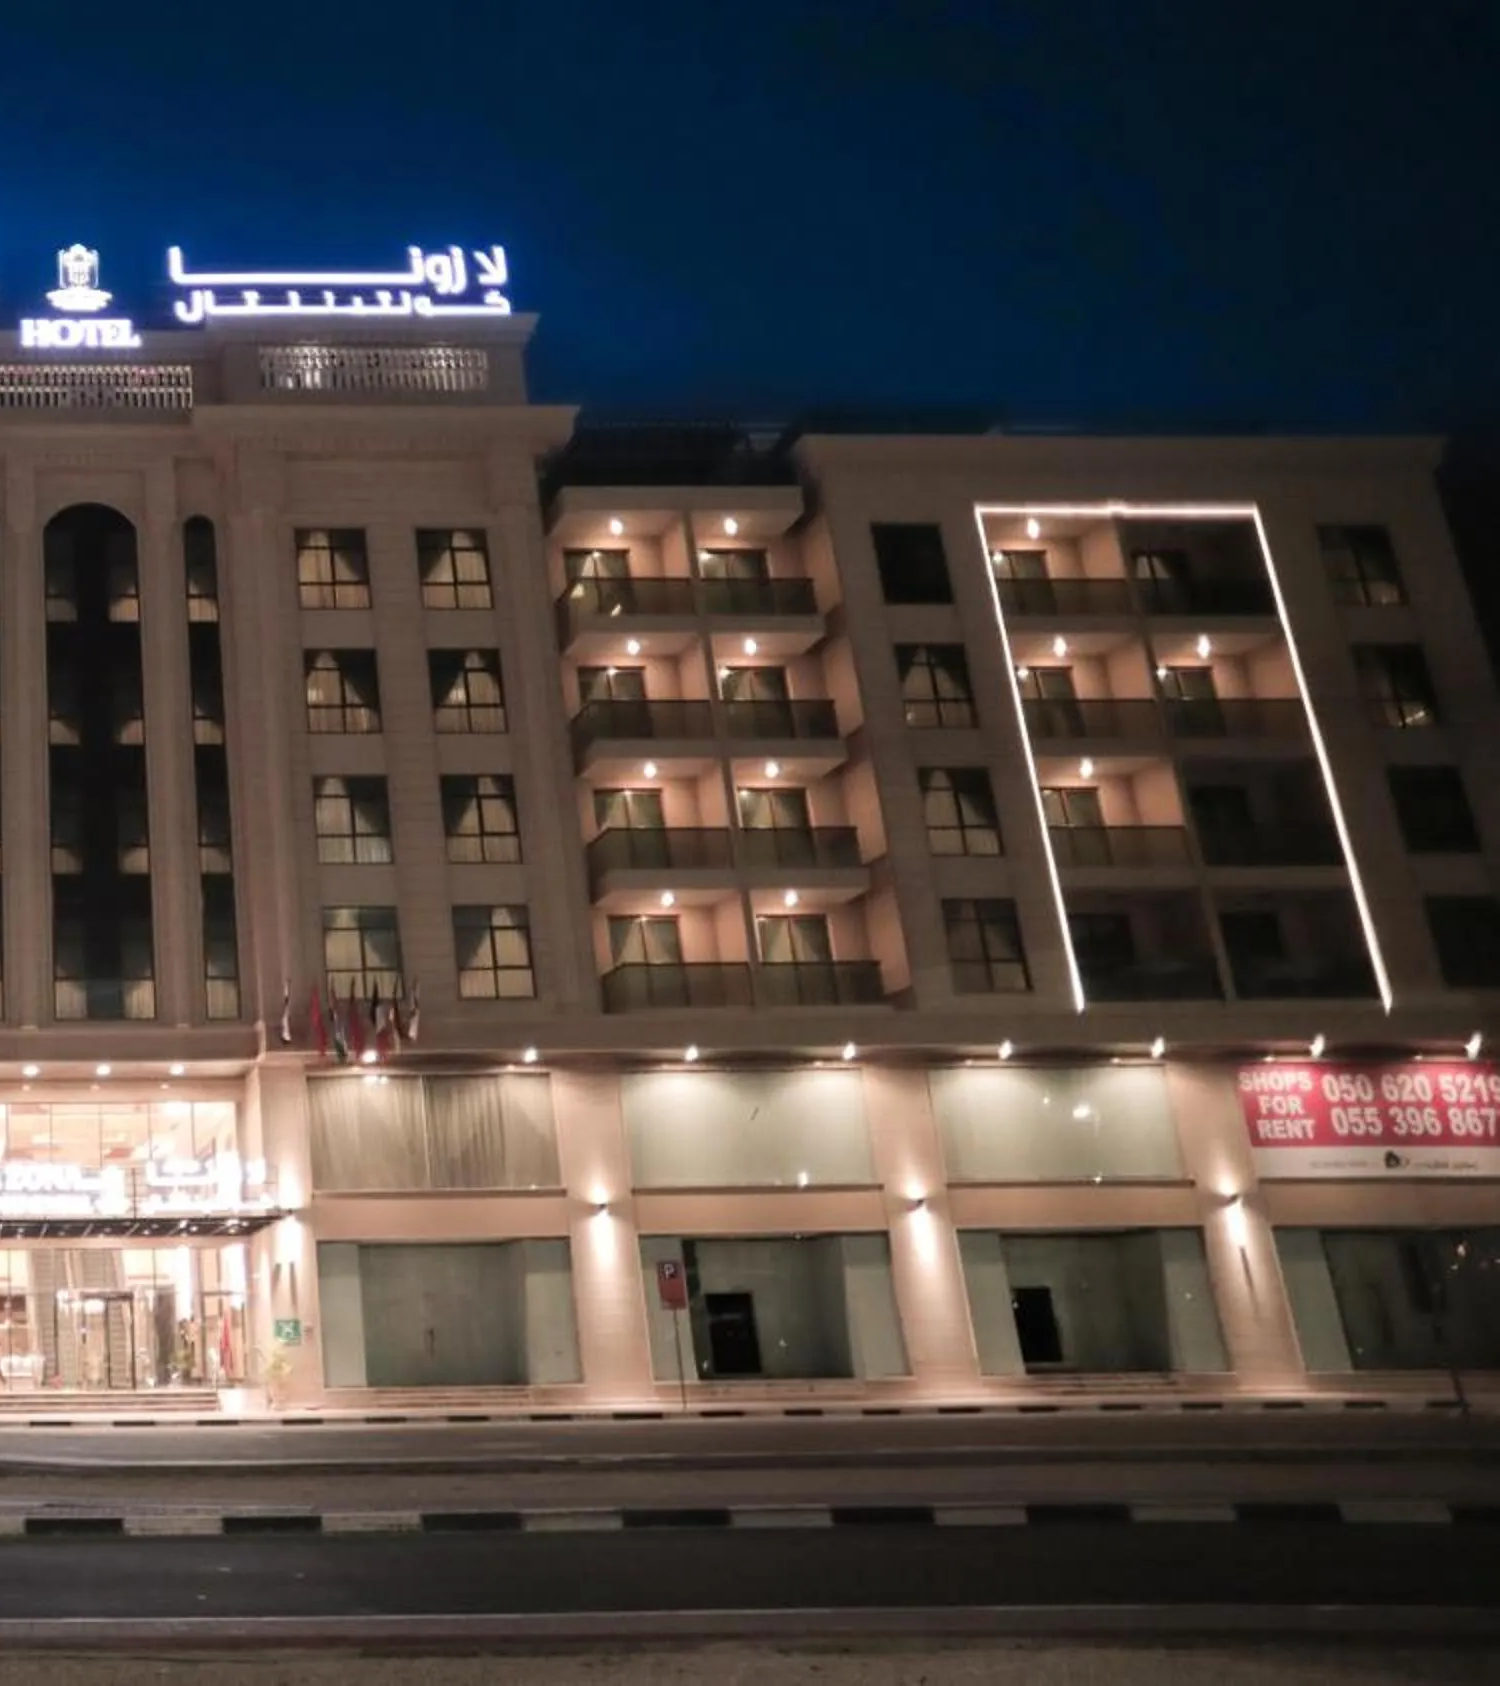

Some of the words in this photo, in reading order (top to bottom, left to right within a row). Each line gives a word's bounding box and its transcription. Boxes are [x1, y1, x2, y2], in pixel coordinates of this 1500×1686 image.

[475, 246, 508, 285] لا
[20, 317, 143, 348] HOTEL
[1238, 1071, 1313, 1092] SHOPS
[1321, 1073, 1374, 1103] 050
[1381, 1073, 1433, 1102] 620
[1257, 1095, 1305, 1116] FOR
[1256, 1119, 1316, 1140] RENT
[1330, 1106, 1383, 1136] 055
[1388, 1106, 1442, 1136] 396
[1447, 1106, 1500, 1137] 867
[663, 1263, 675, 1279] P
